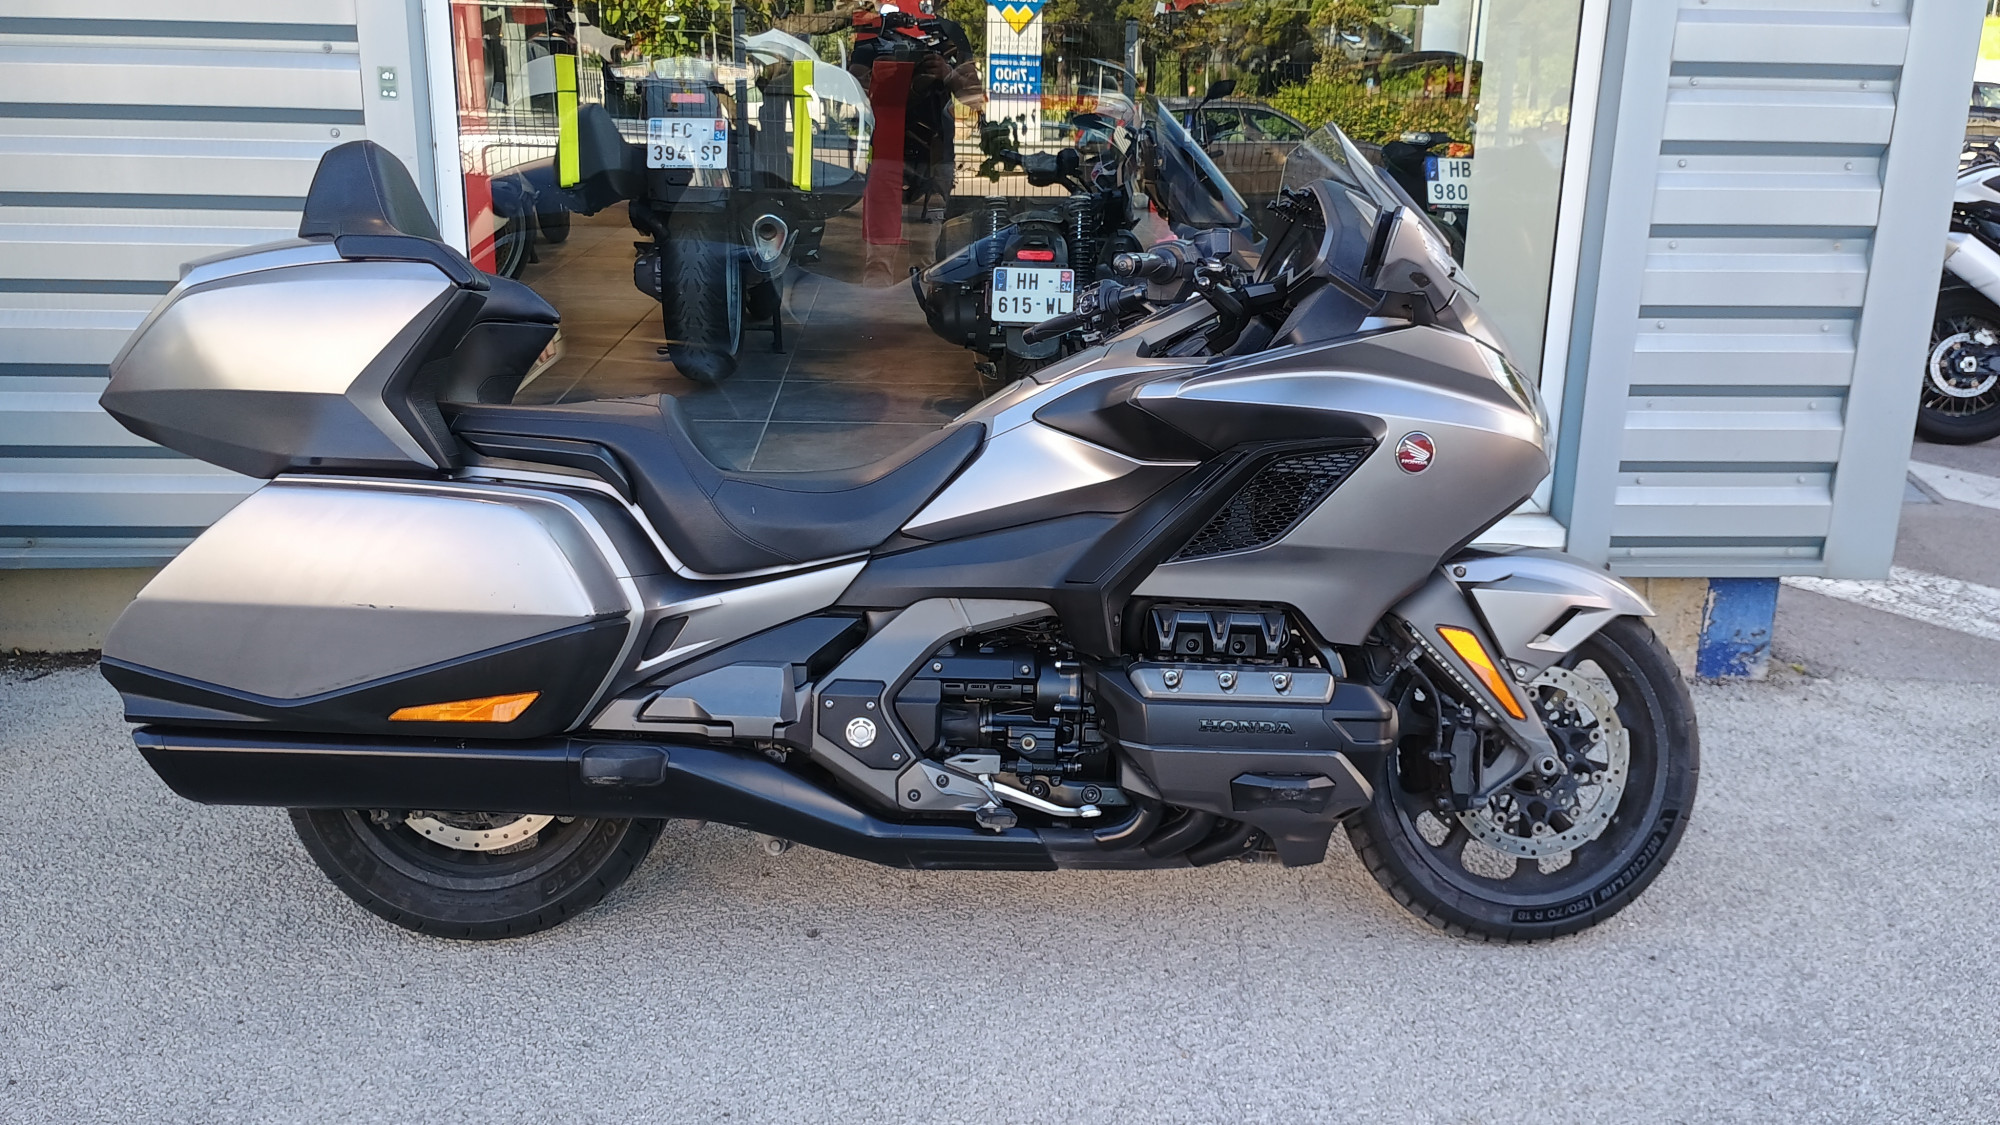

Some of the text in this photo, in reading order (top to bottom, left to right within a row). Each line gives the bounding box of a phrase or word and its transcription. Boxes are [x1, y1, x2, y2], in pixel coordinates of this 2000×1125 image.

[671, 122, 693, 139] FC
[714, 131, 725, 140] 34
[1449, 161, 1472, 178] HB
[1433, 183, 1468, 201] 980
[1016, 272, 1039, 291] HH
[1060, 282, 1071, 292] 34
[1198, 719, 1296, 734] HONDA
[1601, 835, 1662, 900] MICHELIN
[1517, 911, 1531, 920] 18
[1534, 911, 1544, 920] R
